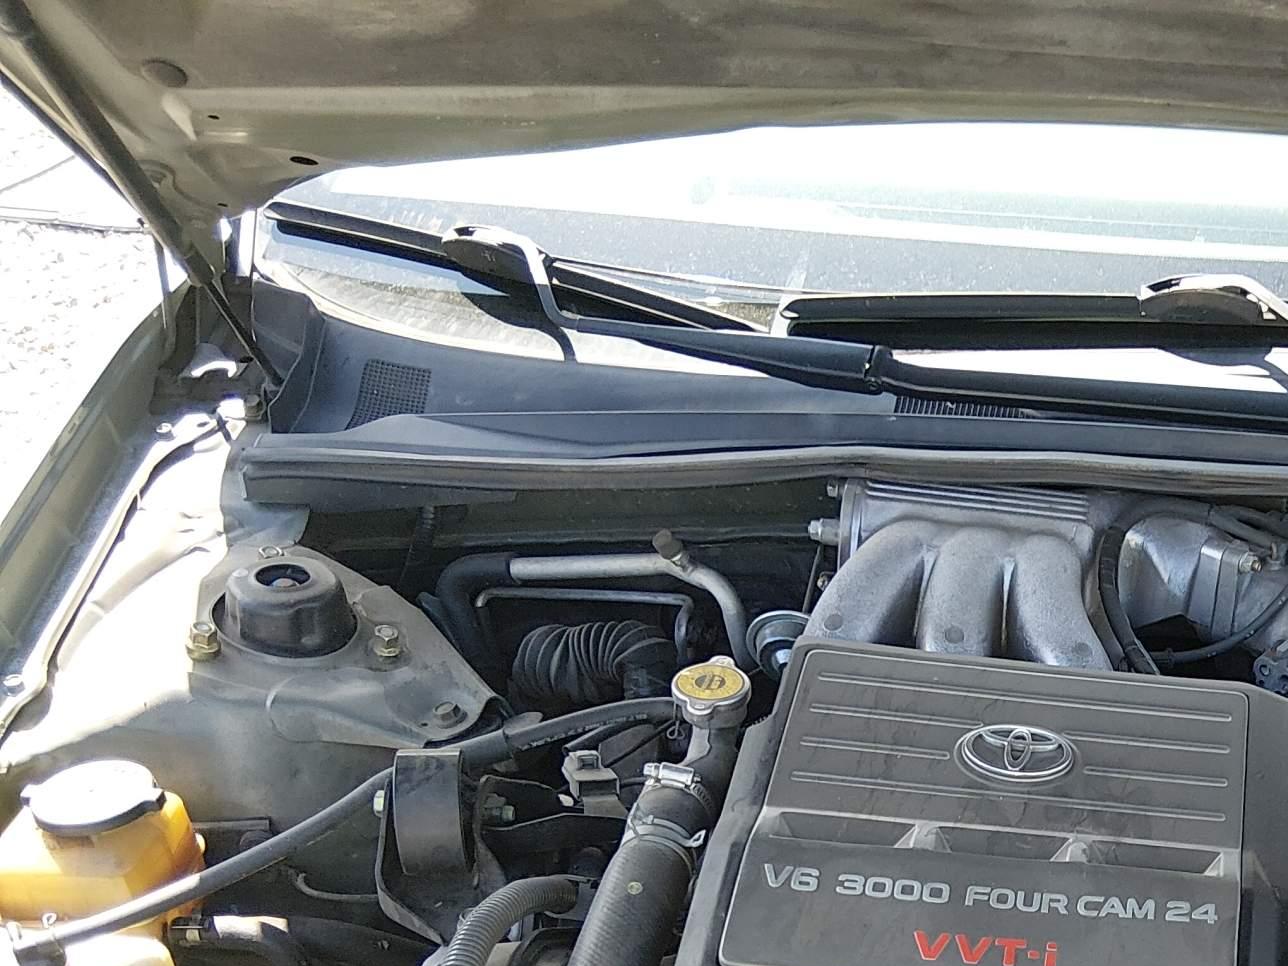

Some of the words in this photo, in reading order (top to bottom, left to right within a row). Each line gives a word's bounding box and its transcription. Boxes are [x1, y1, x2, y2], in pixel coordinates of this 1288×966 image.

[763, 863, 819, 893] V6
[835, 873, 951, 904] 3000
[965, 886, 1068, 916] FOUR
[1077, 895, 1155, 922] CAM
[1165, 901, 1218, 924] 24
